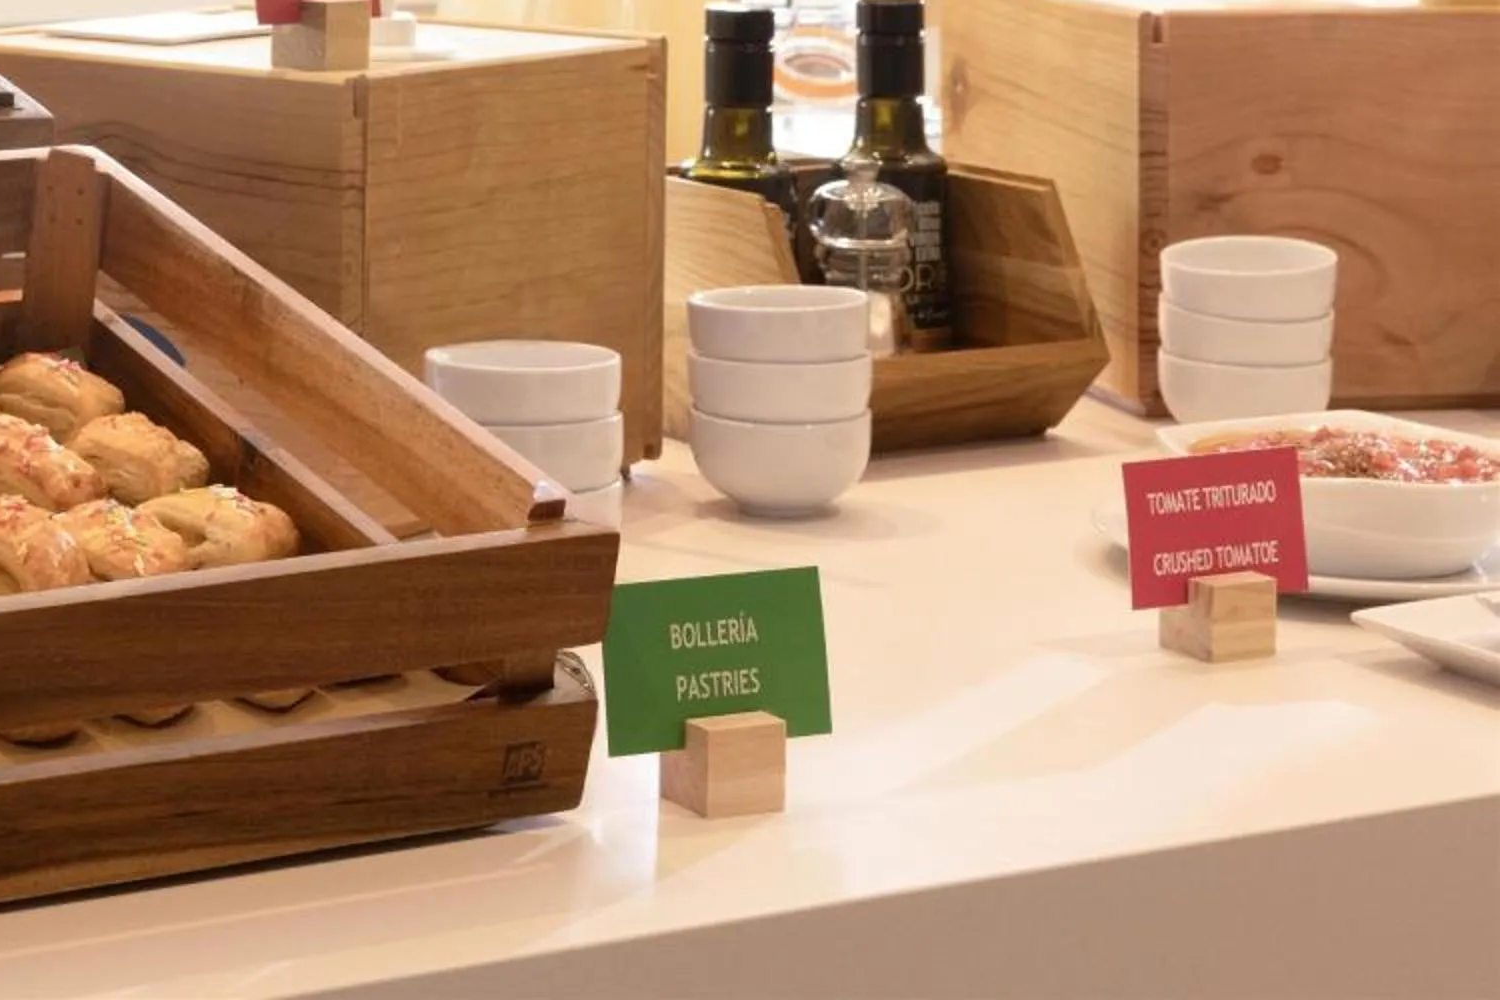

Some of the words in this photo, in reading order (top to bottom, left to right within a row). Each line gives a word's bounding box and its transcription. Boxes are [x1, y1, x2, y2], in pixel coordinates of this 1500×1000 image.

[1147, 487, 1201, 516] TOMATE
[1202, 479, 1277, 510] TRITURADO
[1153, 548, 1213, 577] CRUSHED
[1215, 540, 1279, 569] TOMATOE
[669, 610, 760, 650] BOLLERÍA
[675, 667, 761, 702] PASTRIES
